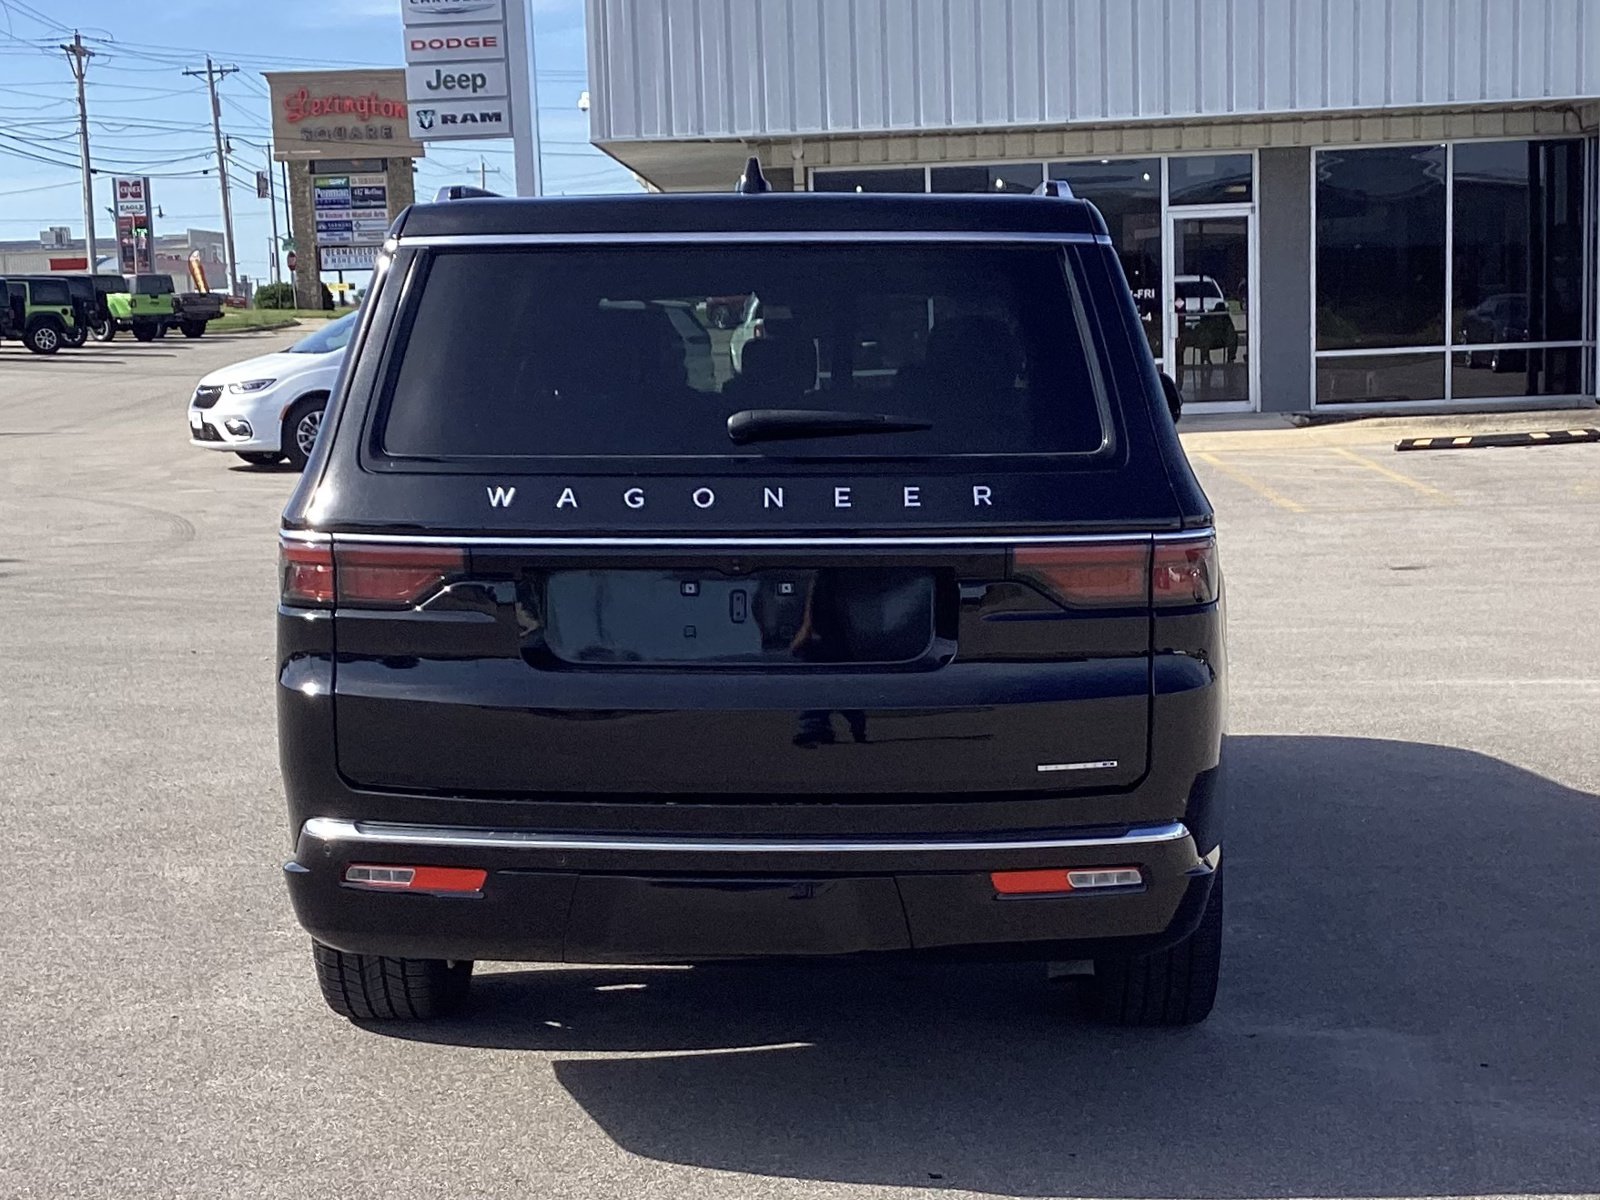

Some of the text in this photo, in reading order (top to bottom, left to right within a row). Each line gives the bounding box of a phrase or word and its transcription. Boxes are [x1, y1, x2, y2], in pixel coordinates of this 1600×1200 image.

[410, 36, 498, 51] DODGE
[425, 69, 488, 93] Jeep
[285, 87, 406, 122] Lexington
[441, 111, 503, 125] RAM
[300, 124, 394, 141] SQUARE
[486, 484, 994, 510] WAGONEER
